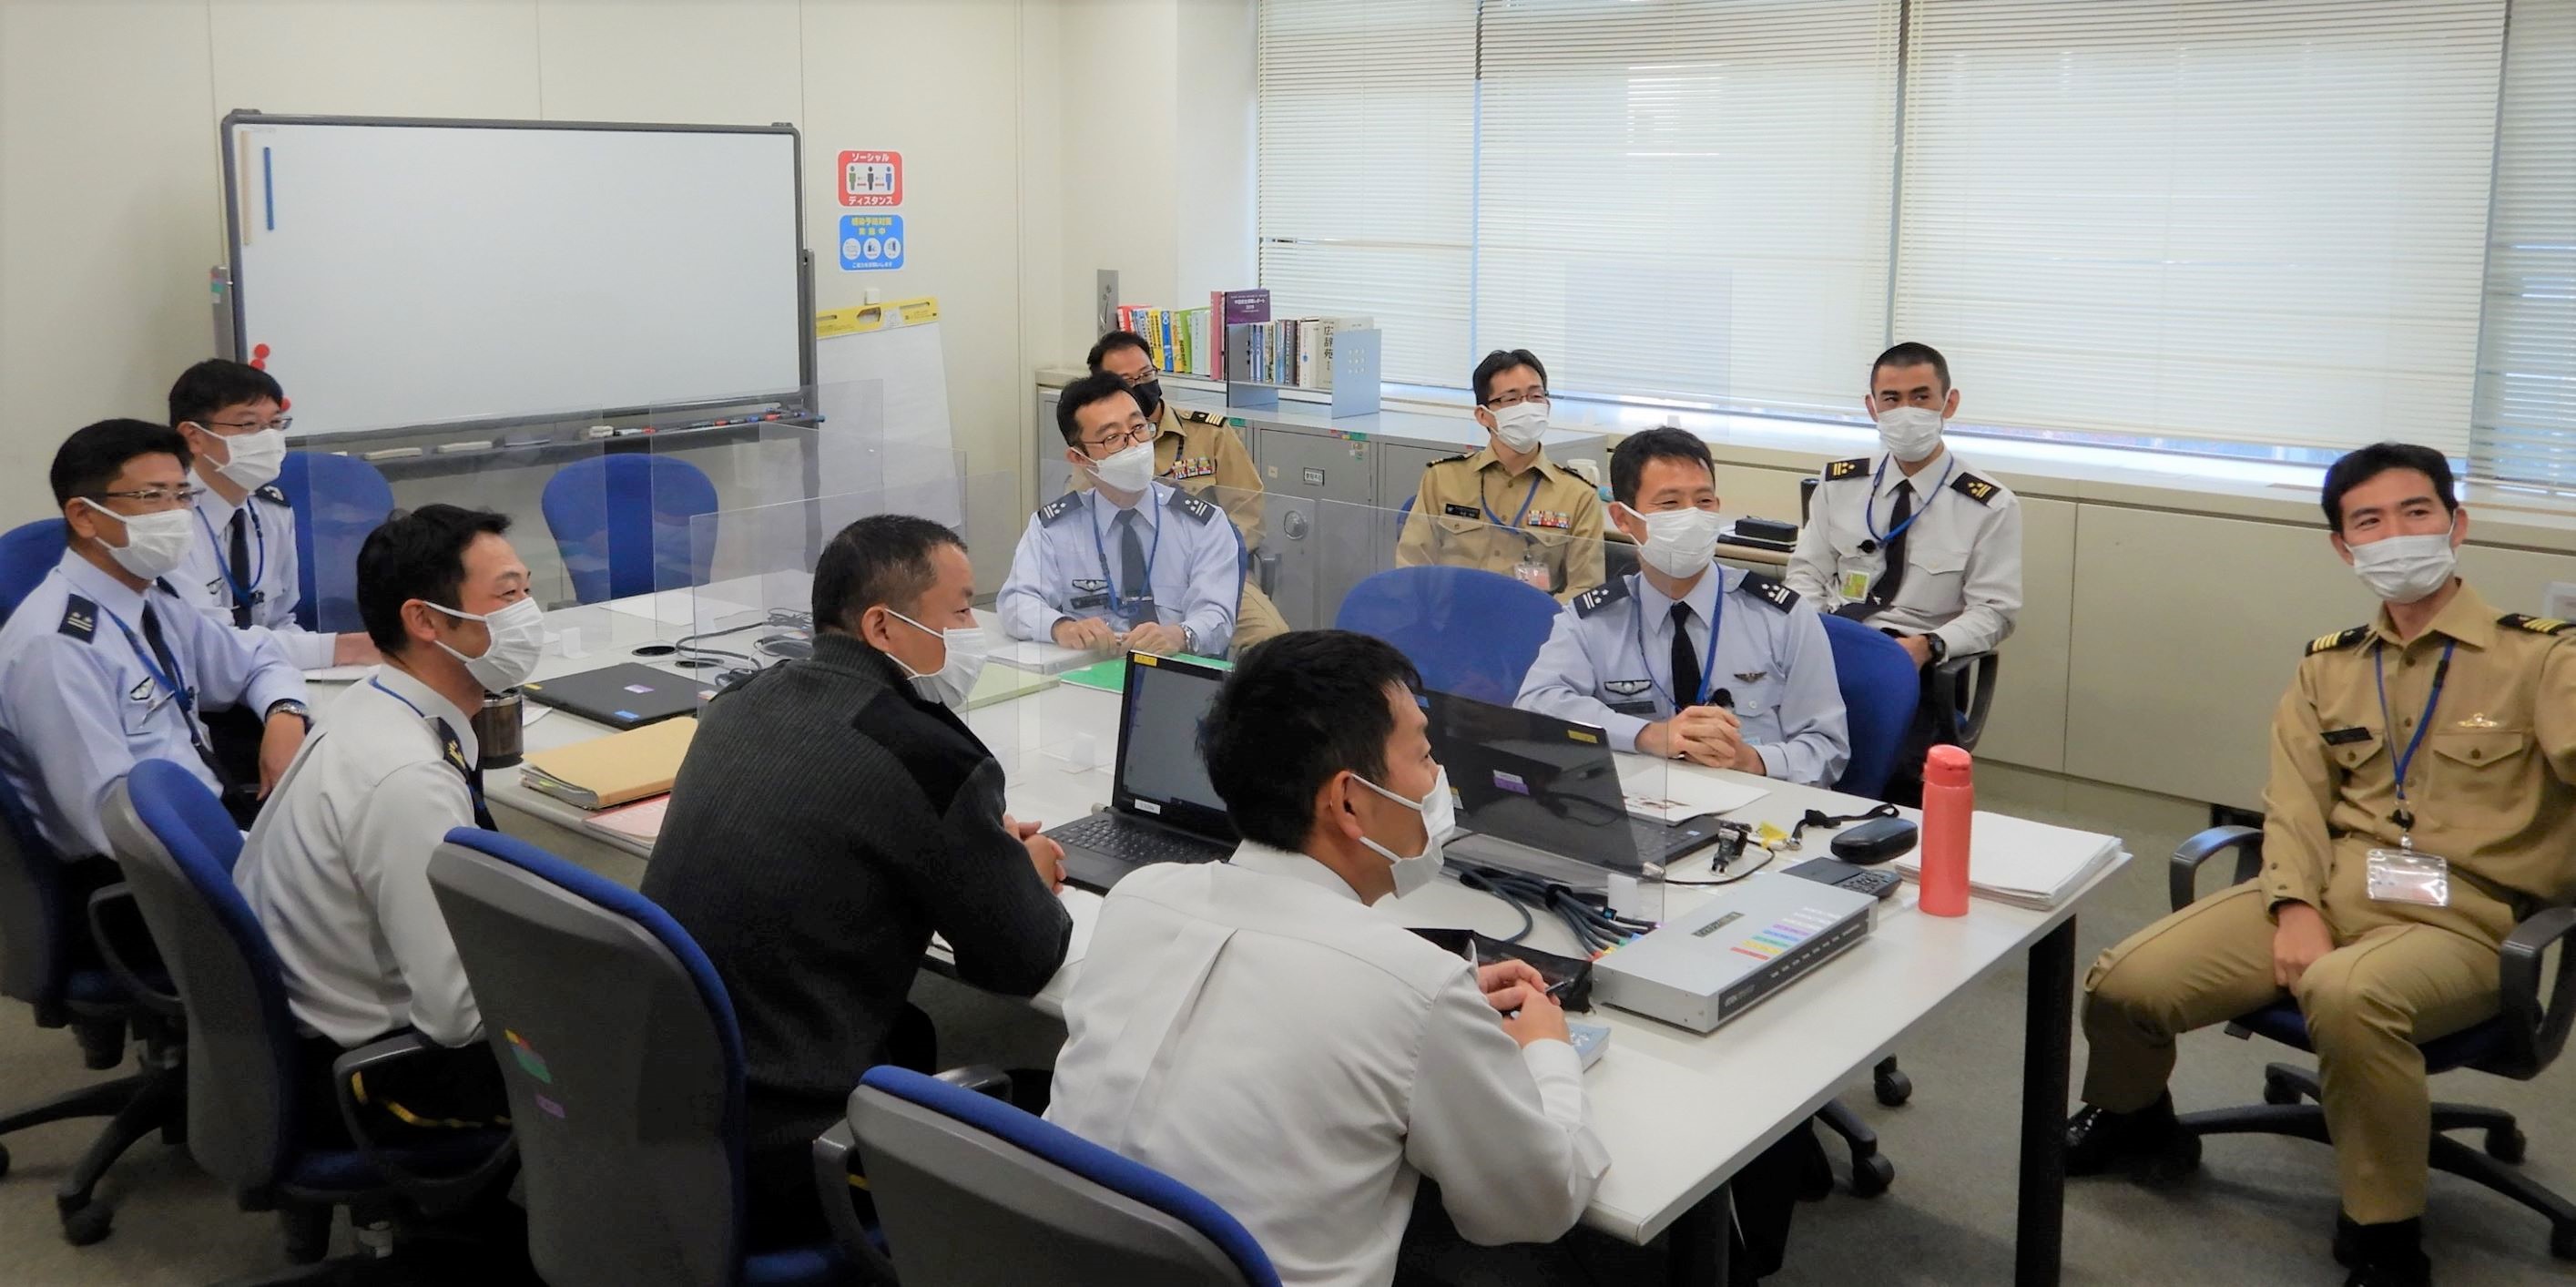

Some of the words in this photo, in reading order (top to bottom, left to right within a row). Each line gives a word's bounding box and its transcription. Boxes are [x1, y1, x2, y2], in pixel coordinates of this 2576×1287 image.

[851, 153, 890, 162] ソーシャル
[849, 196, 893, 206] ディスタンス
[1324, 325, 1334, 359] 広辞苑
